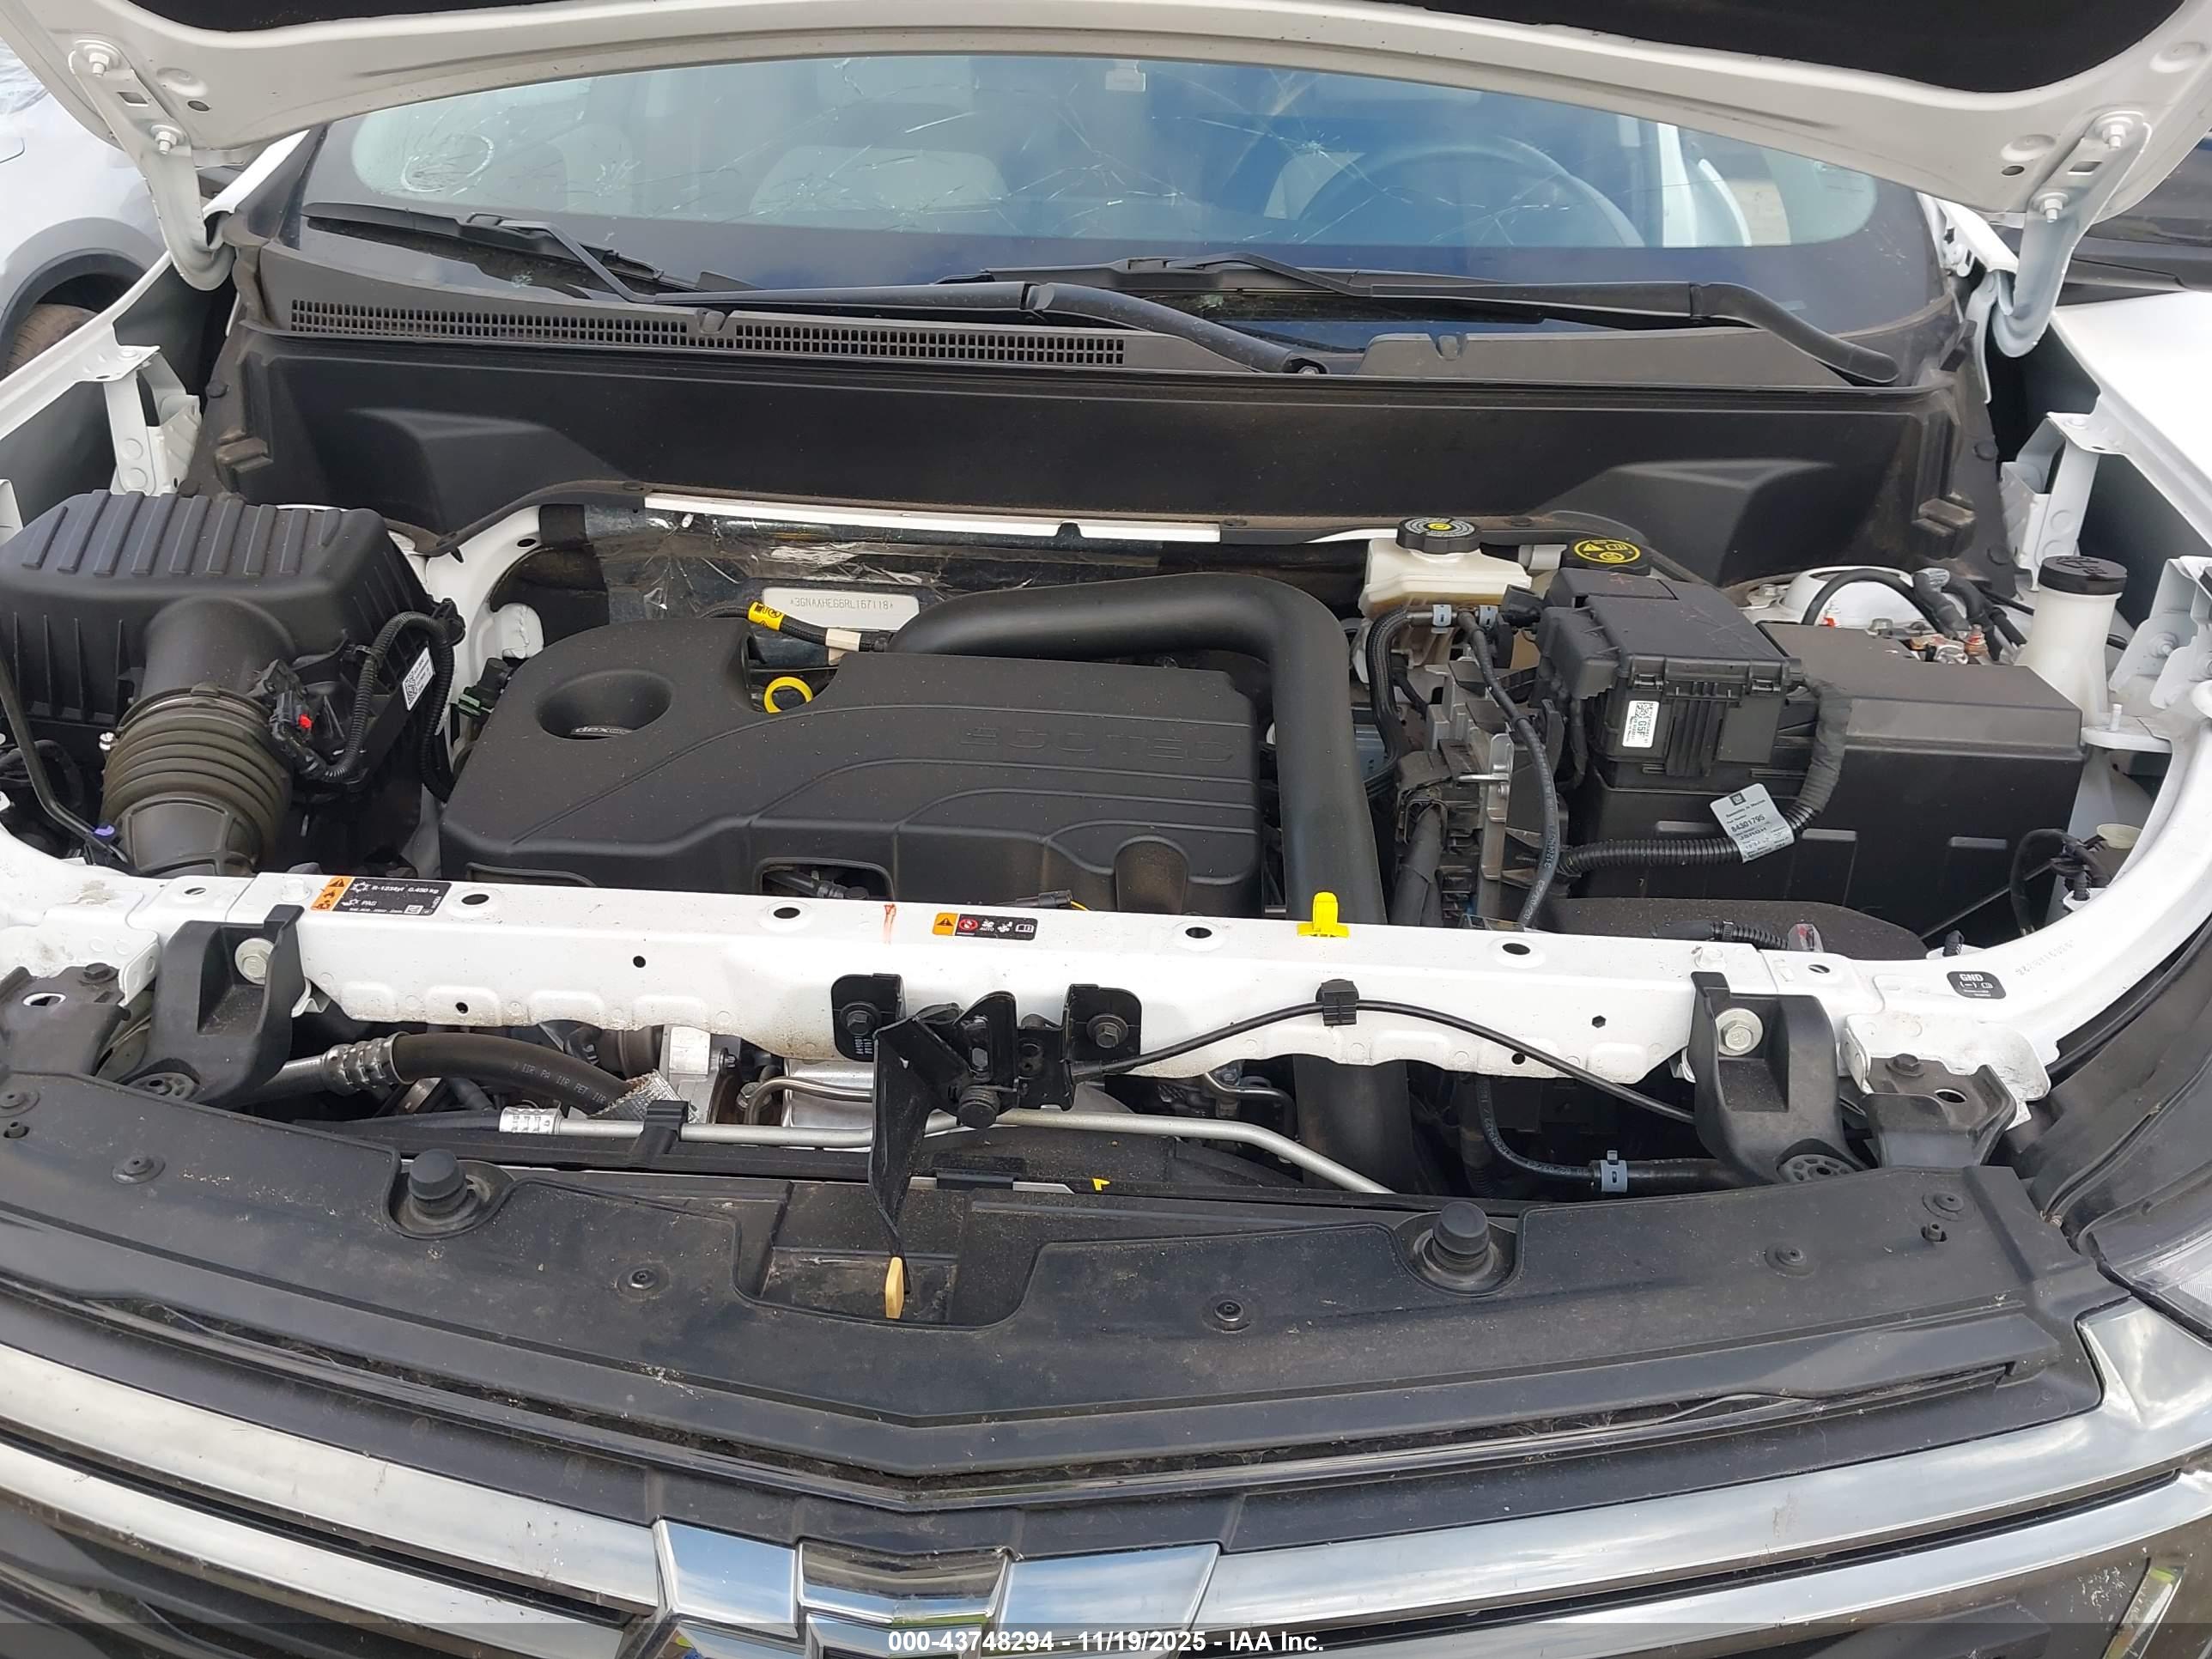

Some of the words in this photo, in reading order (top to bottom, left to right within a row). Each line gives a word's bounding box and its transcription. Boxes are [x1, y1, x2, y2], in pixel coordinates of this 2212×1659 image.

[959, 726, 1235, 763] ECOTEC
[1730, 814, 1765, 833] 84301795
[573, 1083, 589, 1095] PET
